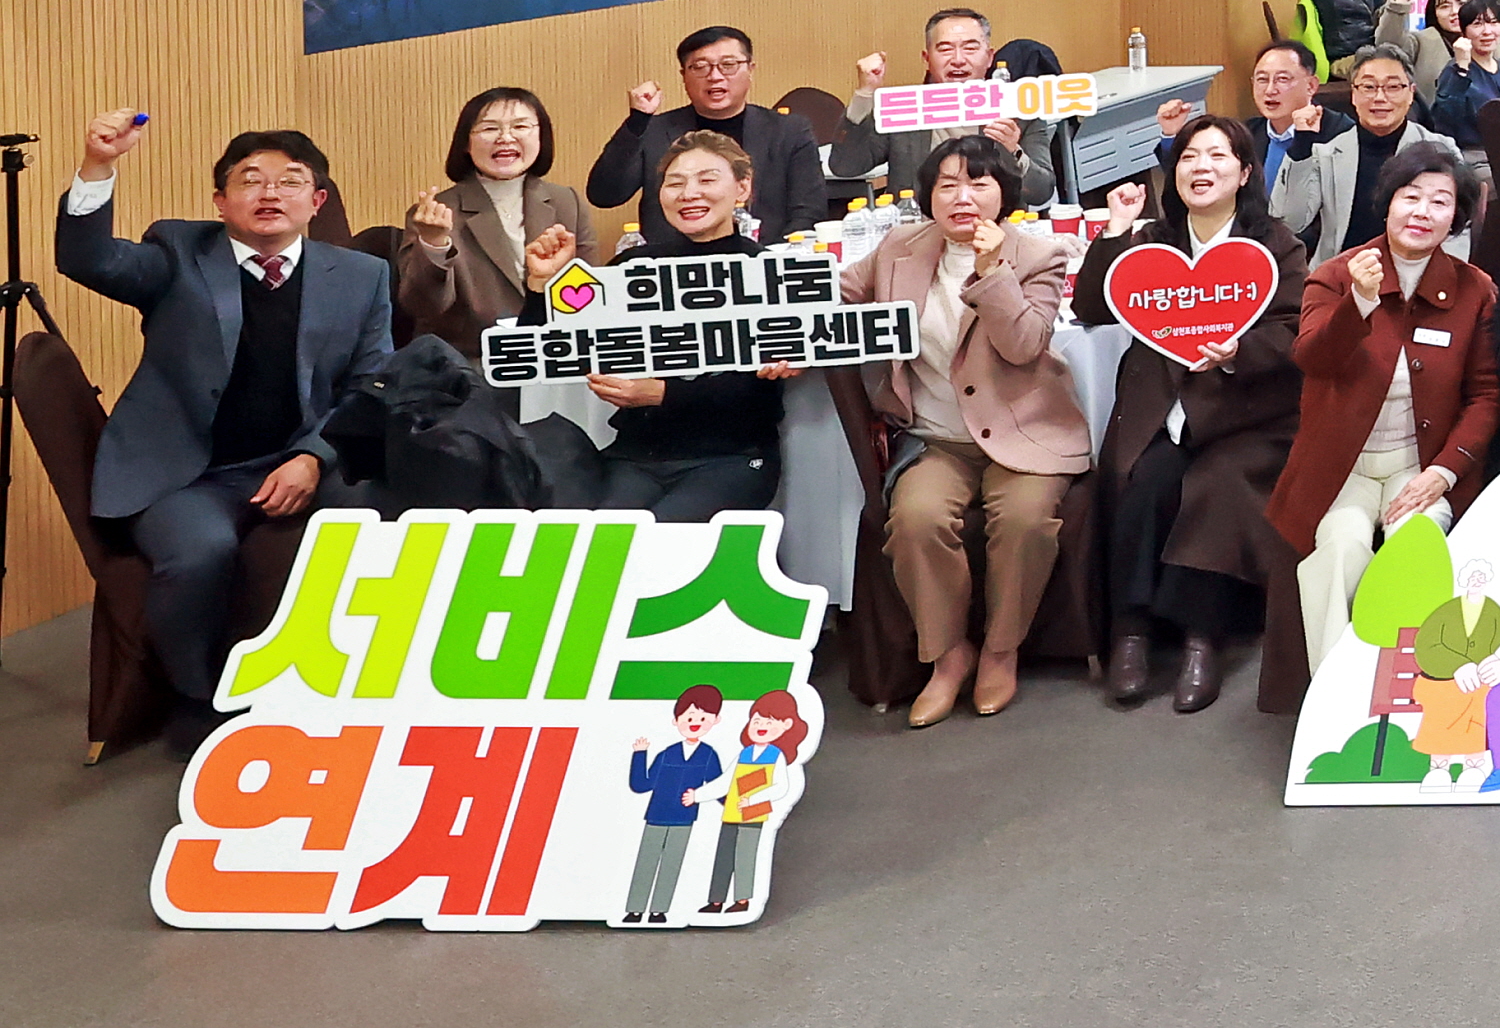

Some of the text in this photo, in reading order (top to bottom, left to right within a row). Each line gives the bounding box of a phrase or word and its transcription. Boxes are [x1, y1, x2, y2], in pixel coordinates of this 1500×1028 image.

[879, 76, 1093, 128] 든든한 이웃
[624, 258, 834, 313] 희망나눔
[1128, 282, 1243, 311] 사랑합니다
[489, 308, 914, 382] 통합돌봄마을센터
[228, 522, 811, 700] 서비스
[164, 725, 579, 916] 연계
